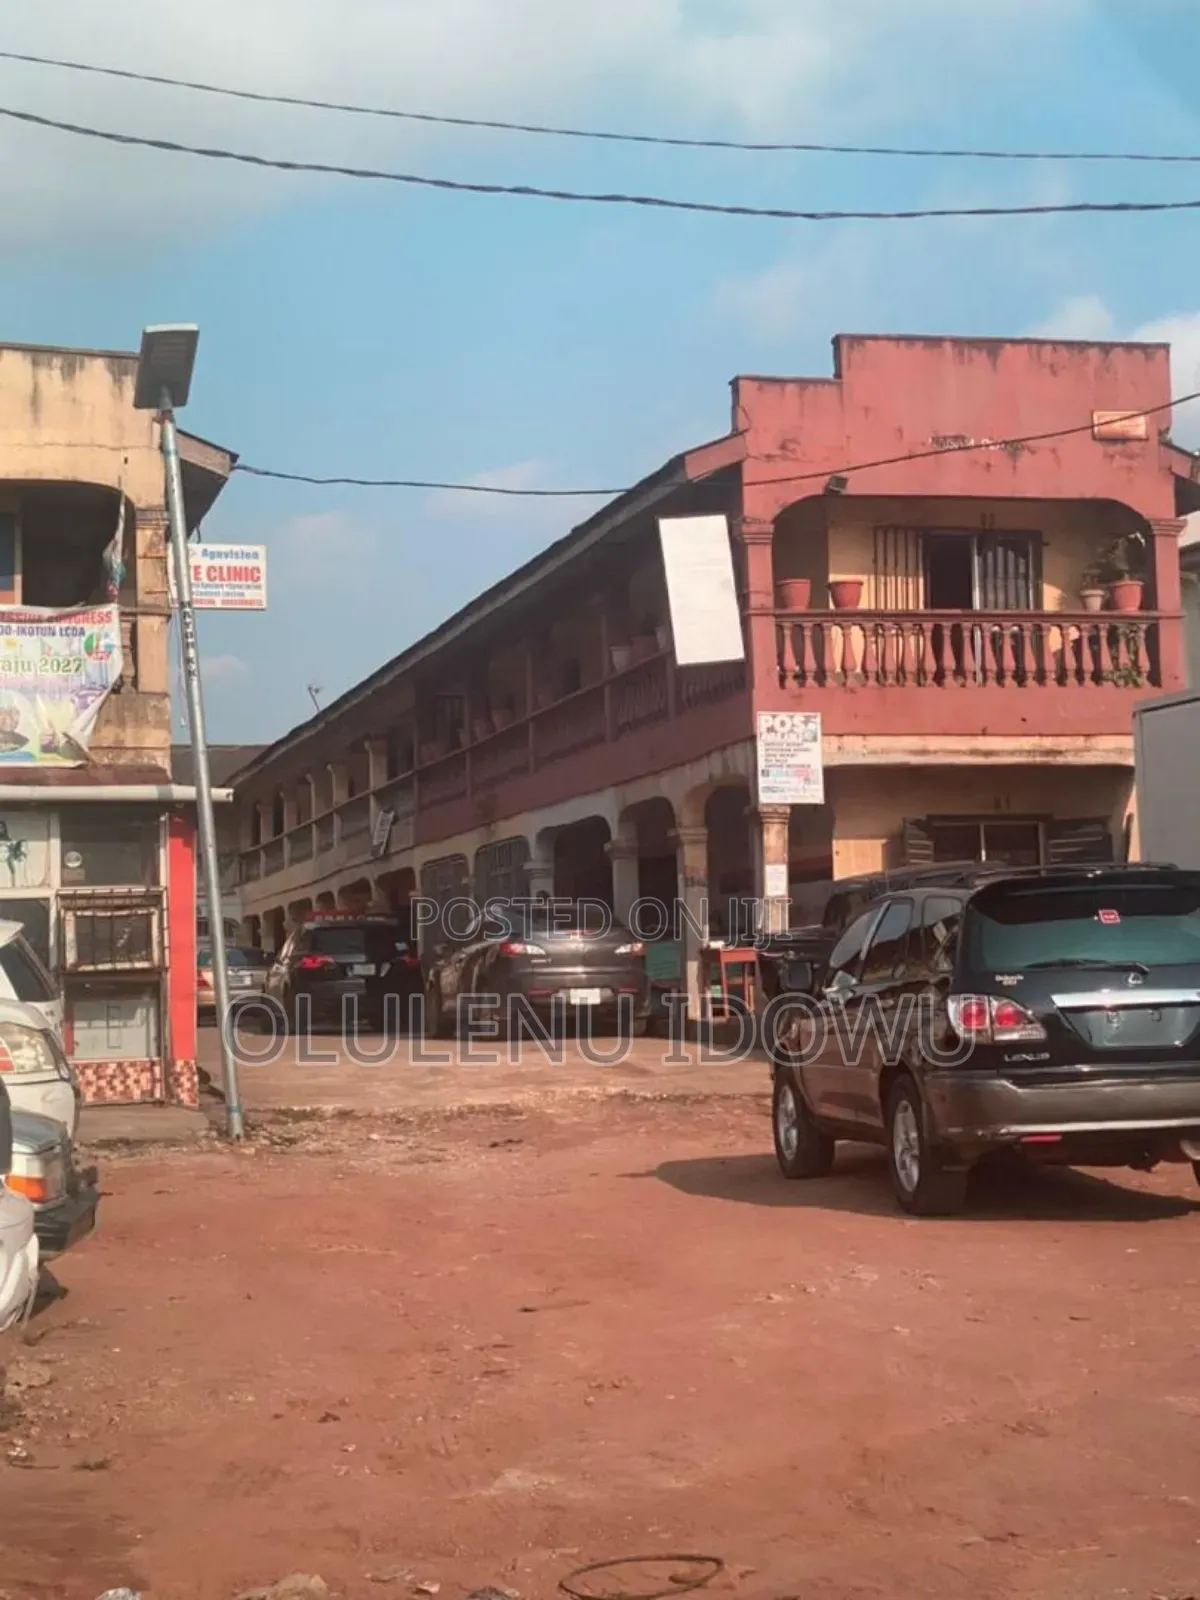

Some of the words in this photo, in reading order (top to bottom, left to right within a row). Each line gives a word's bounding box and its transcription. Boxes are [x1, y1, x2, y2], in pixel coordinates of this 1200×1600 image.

[206, 565, 262, 583] CLINIC
[0, 660, 32, 673] aju
[39, 657, 83, 673] 2027
